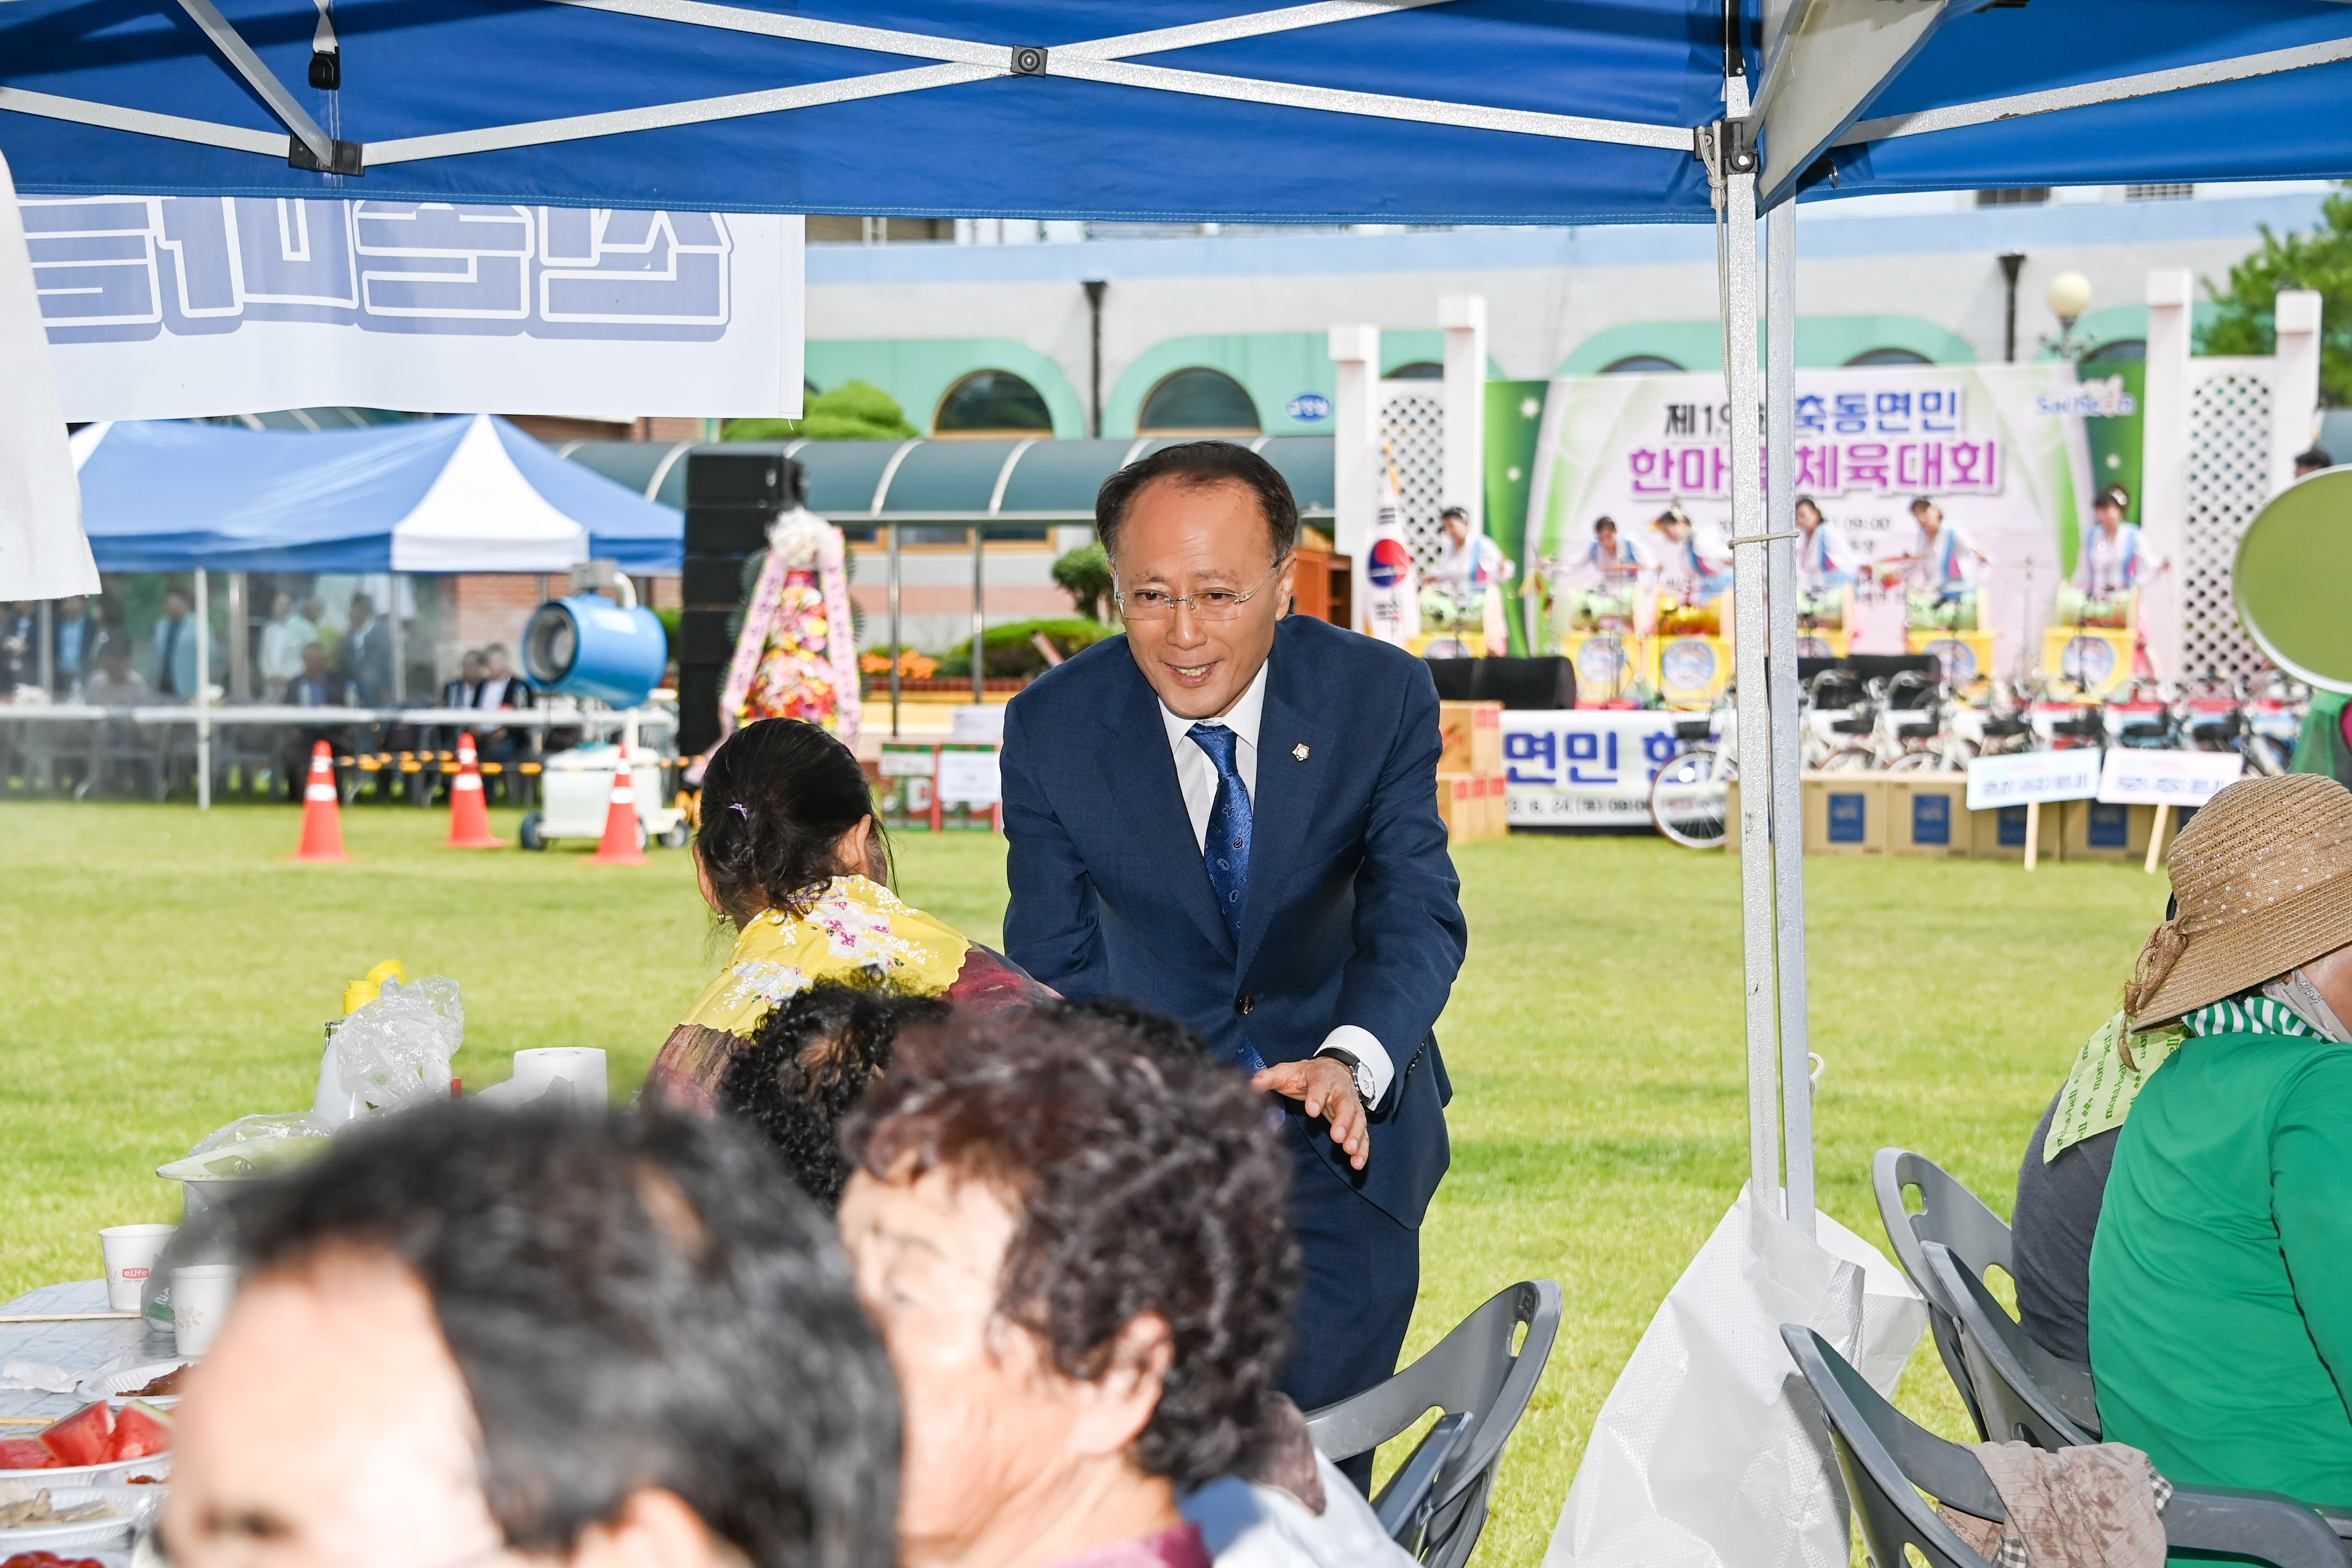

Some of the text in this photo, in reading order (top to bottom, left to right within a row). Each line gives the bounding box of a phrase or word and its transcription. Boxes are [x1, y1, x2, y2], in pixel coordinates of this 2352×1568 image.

[1663, 403, 1766, 437] 제19
[1630, 441, 1994, 493] 한마 체육대회
